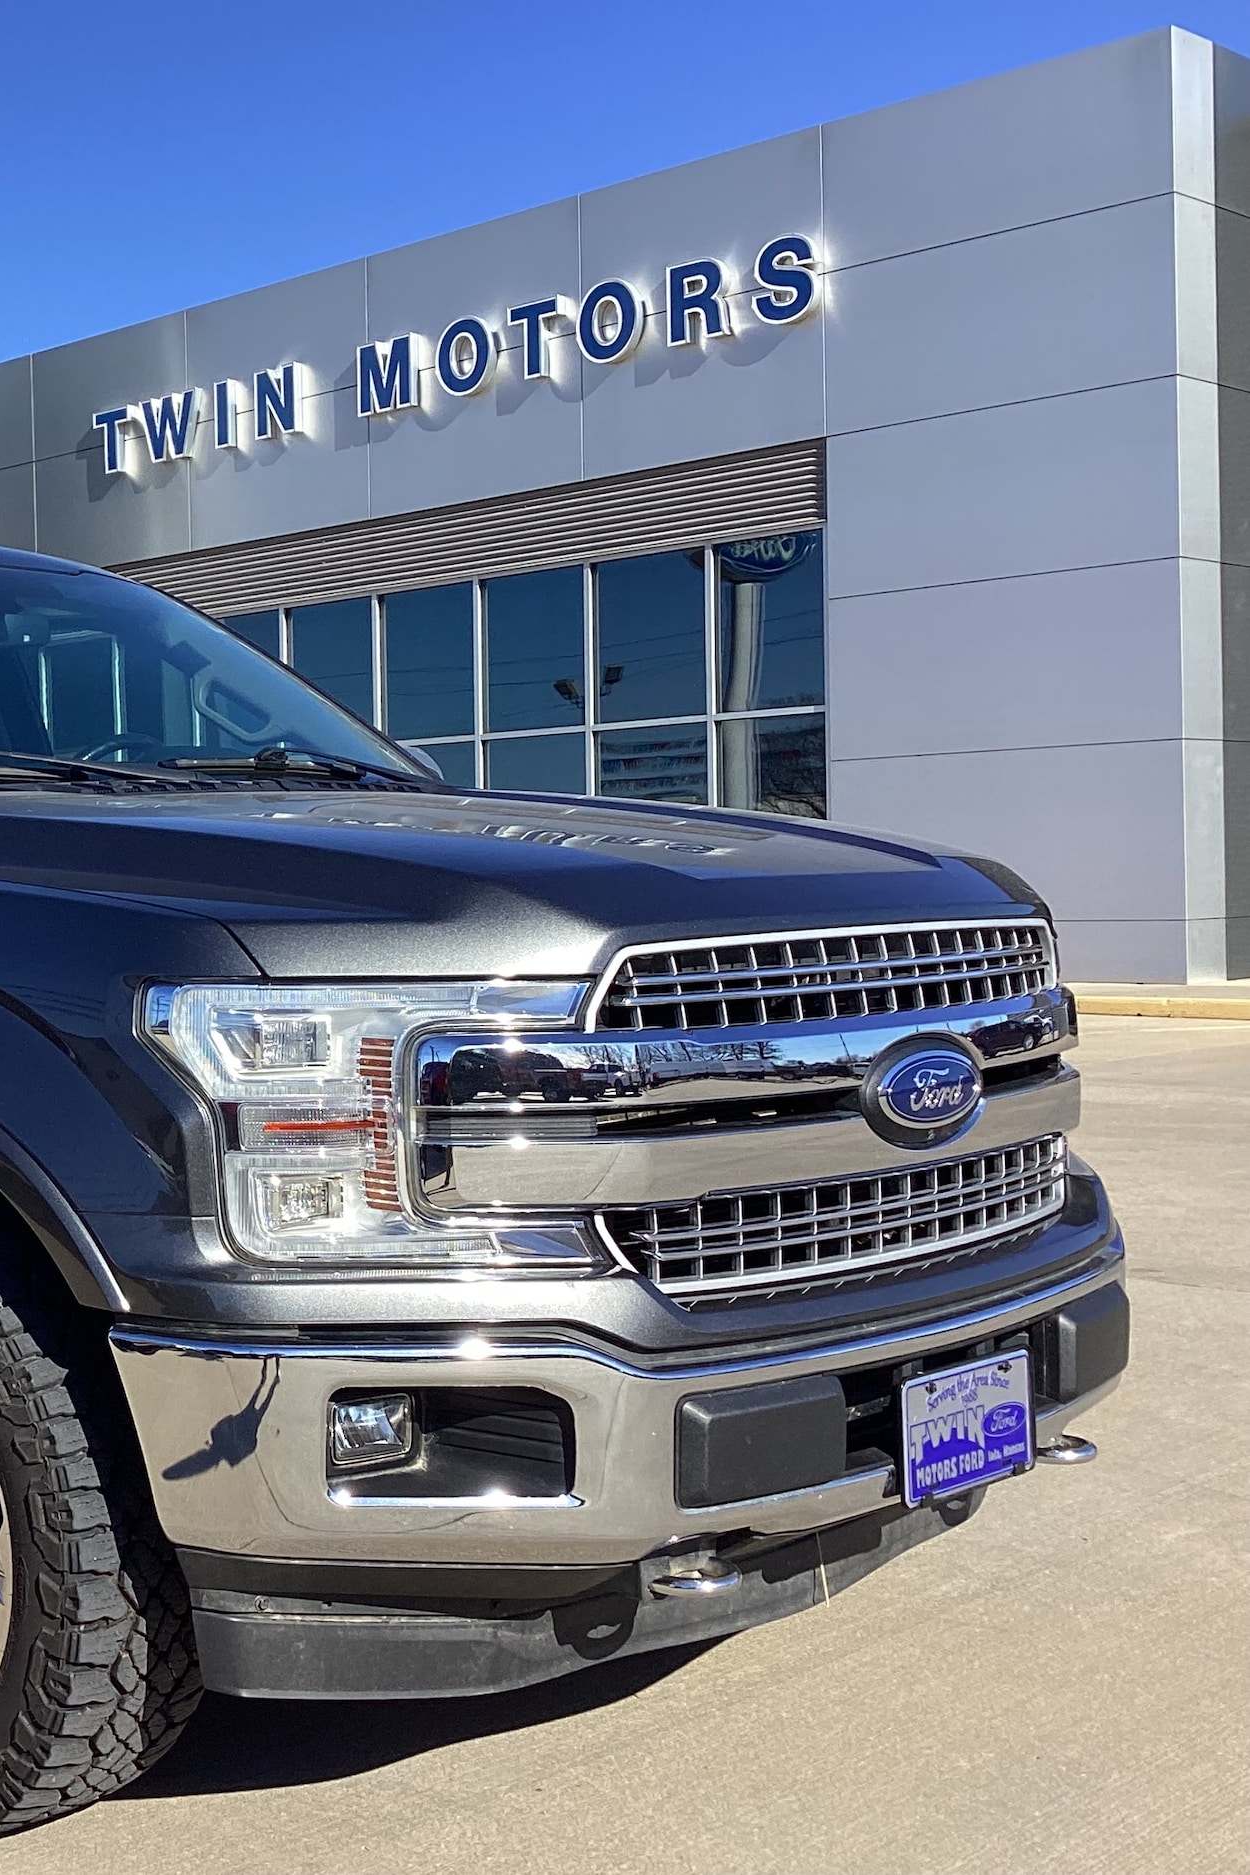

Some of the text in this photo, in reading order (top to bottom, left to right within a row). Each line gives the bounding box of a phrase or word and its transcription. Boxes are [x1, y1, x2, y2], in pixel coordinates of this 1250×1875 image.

[93, 232, 824, 474] TWIN MOTORS
[910, 1068, 964, 1111] Ford
[957, 1375, 969, 1392] the
[970, 1372, 988, 1387] Area
[910, 1404, 985, 1466] TWIN
[990, 1408, 1018, 1432] Ford
[916, 1450, 985, 1489] MOTORS FORD
